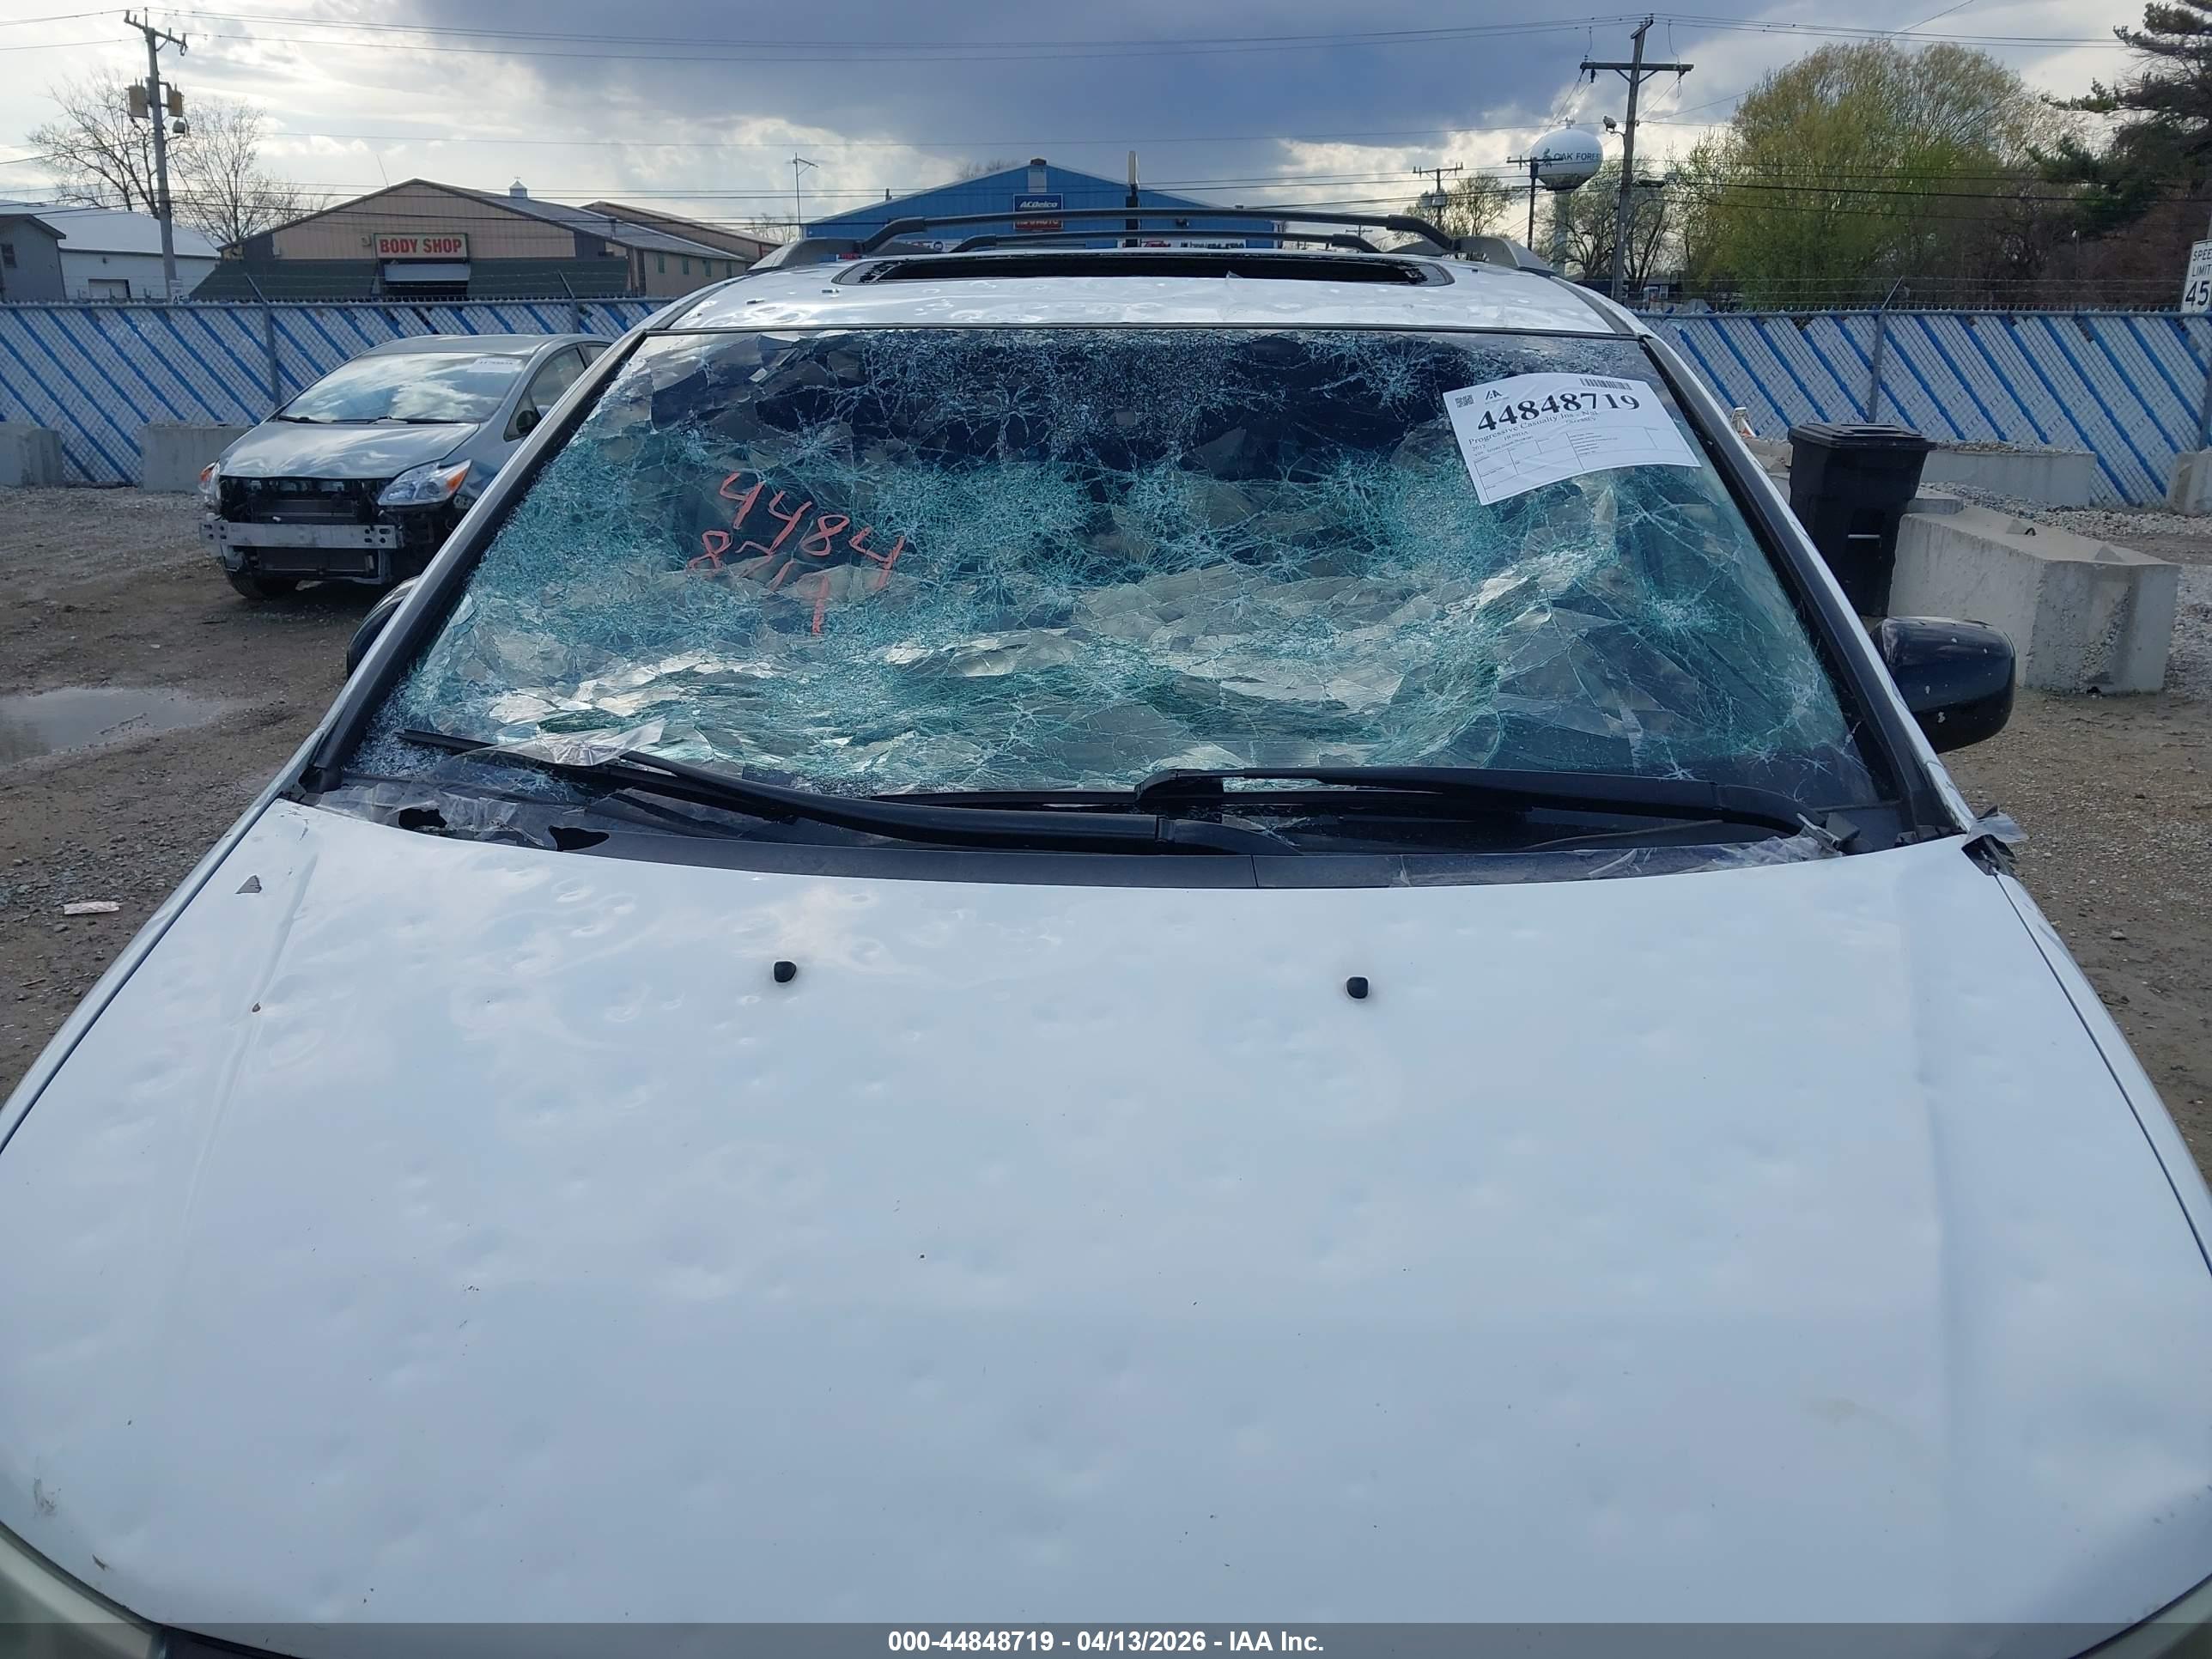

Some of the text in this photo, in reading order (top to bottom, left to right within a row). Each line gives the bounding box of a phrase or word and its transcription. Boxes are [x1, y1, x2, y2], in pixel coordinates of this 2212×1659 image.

[380, 239, 462, 253] BODY SHOP
[2192, 248, 2212, 262] SPEE
[2191, 264, 2212, 277] LIMIT
[2185, 280, 2210, 307] 45
[1477, 392, 1640, 431] 44848719
[1468, 425, 1518, 446] Progressive
[1520, 415, 1559, 429] Casualty
[719, 471, 907, 592] 4484
